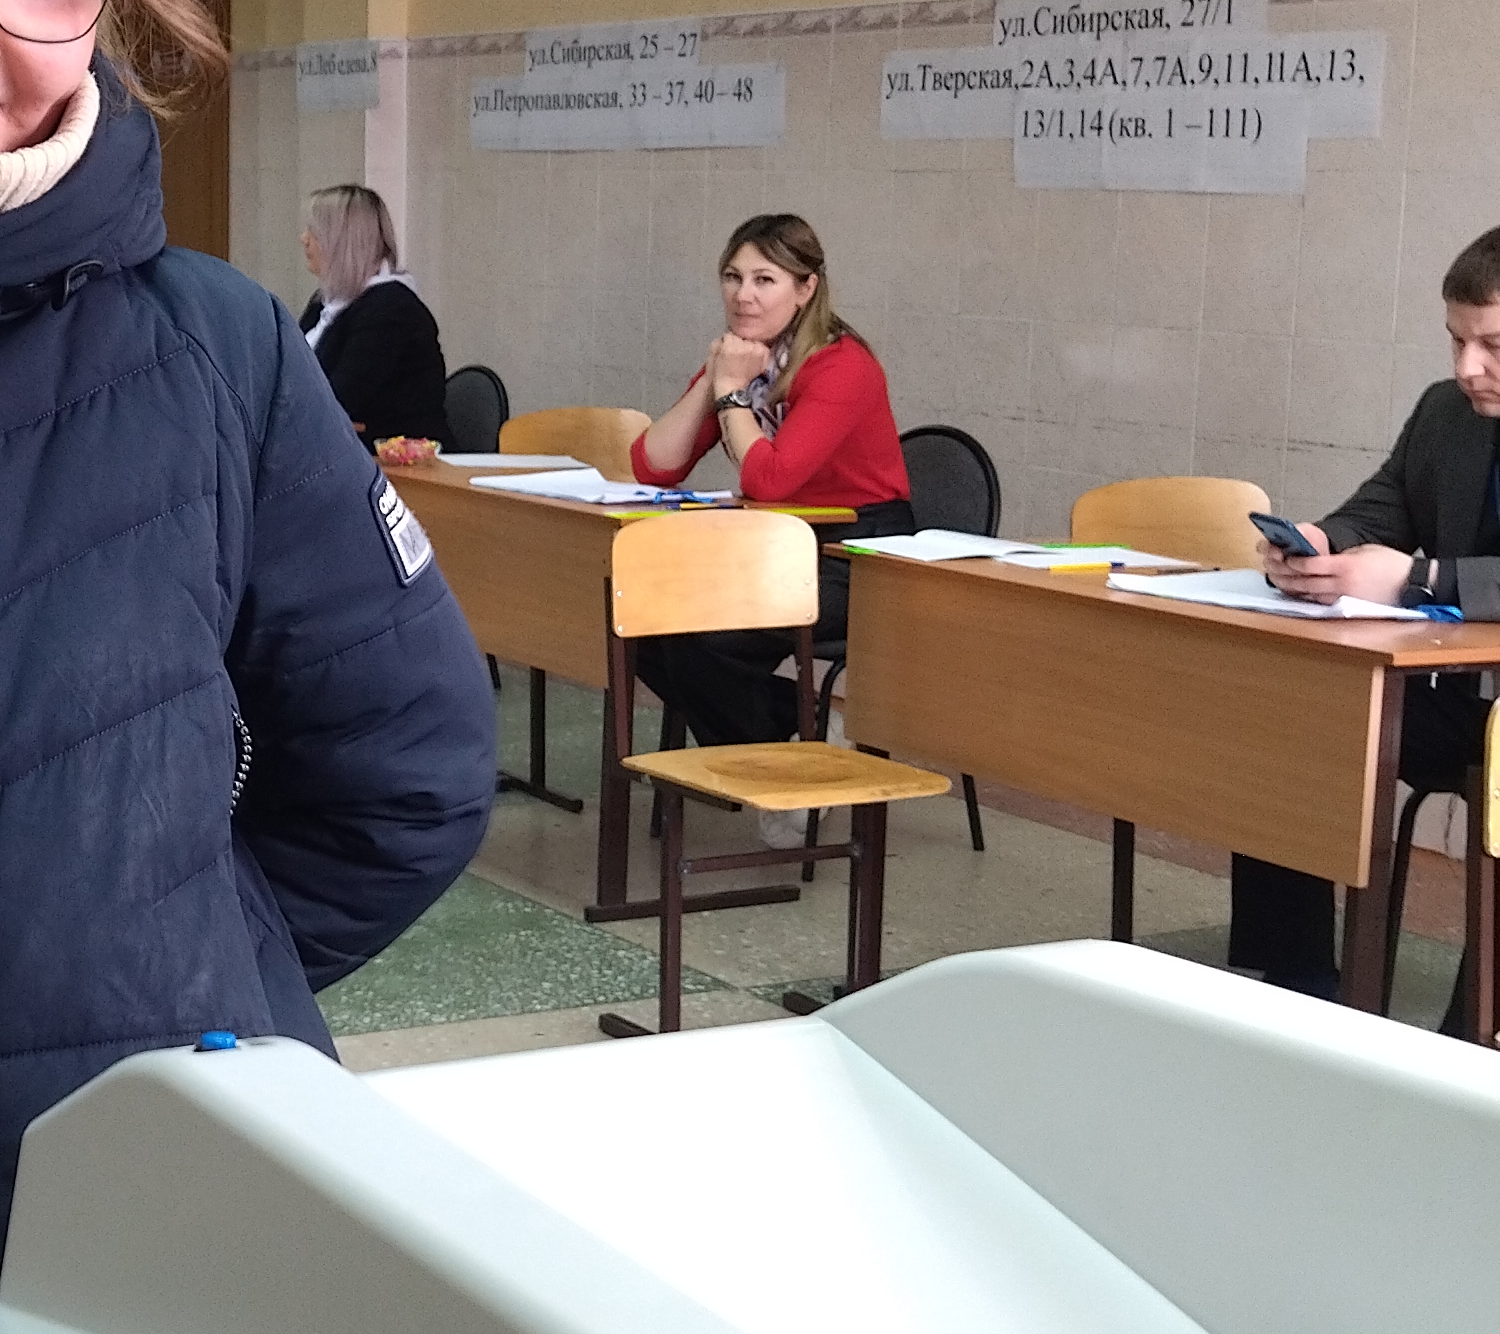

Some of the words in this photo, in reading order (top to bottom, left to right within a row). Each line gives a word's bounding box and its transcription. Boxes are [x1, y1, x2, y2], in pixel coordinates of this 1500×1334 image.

[998, 3, 1171, 46] ул.Сибирская,
[639, 33, 658, 59] 25
[677, 31, 698, 57] 27
[629, 81, 647, 107] 33
[693, 77, 715, 103] 40
[732, 76, 754, 103] 48
